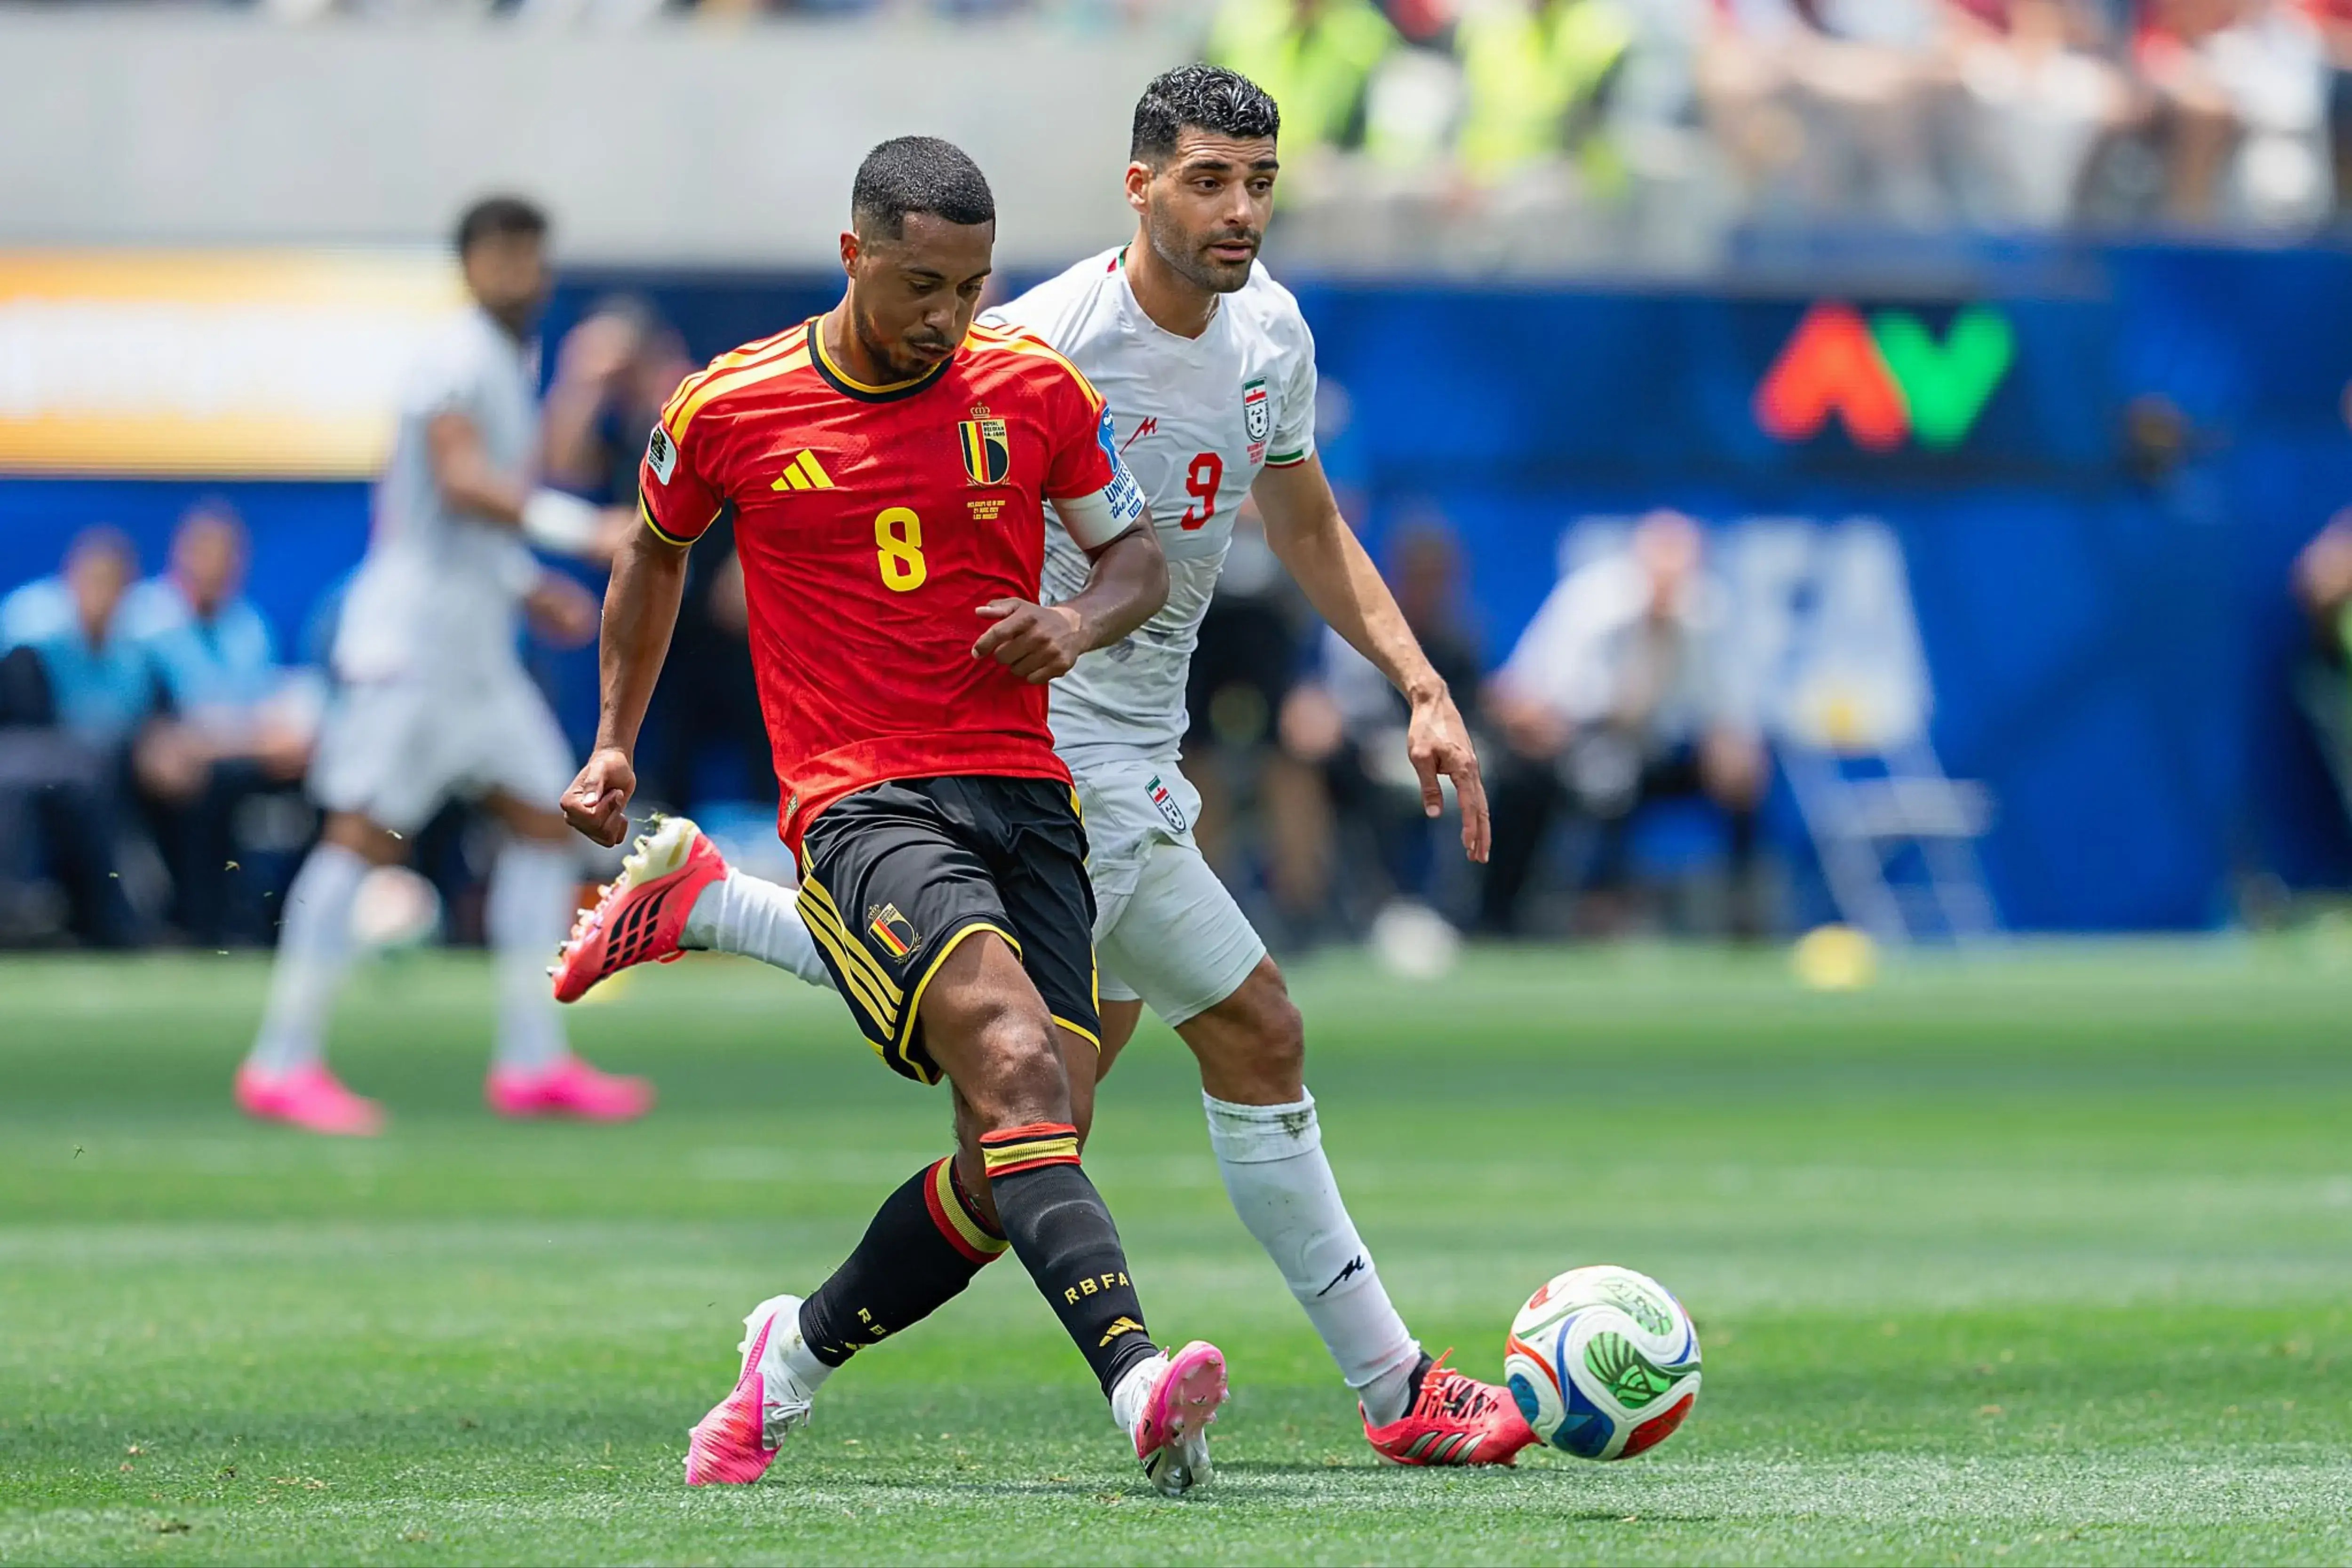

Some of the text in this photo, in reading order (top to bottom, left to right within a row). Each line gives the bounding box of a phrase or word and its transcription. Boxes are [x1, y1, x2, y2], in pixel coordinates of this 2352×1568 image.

[1181, 452, 1223, 531] 9
[875, 507, 927, 591] 8
[1064, 1272, 1129, 1305] RBFA
[858, 1308, 888, 1335] RB
